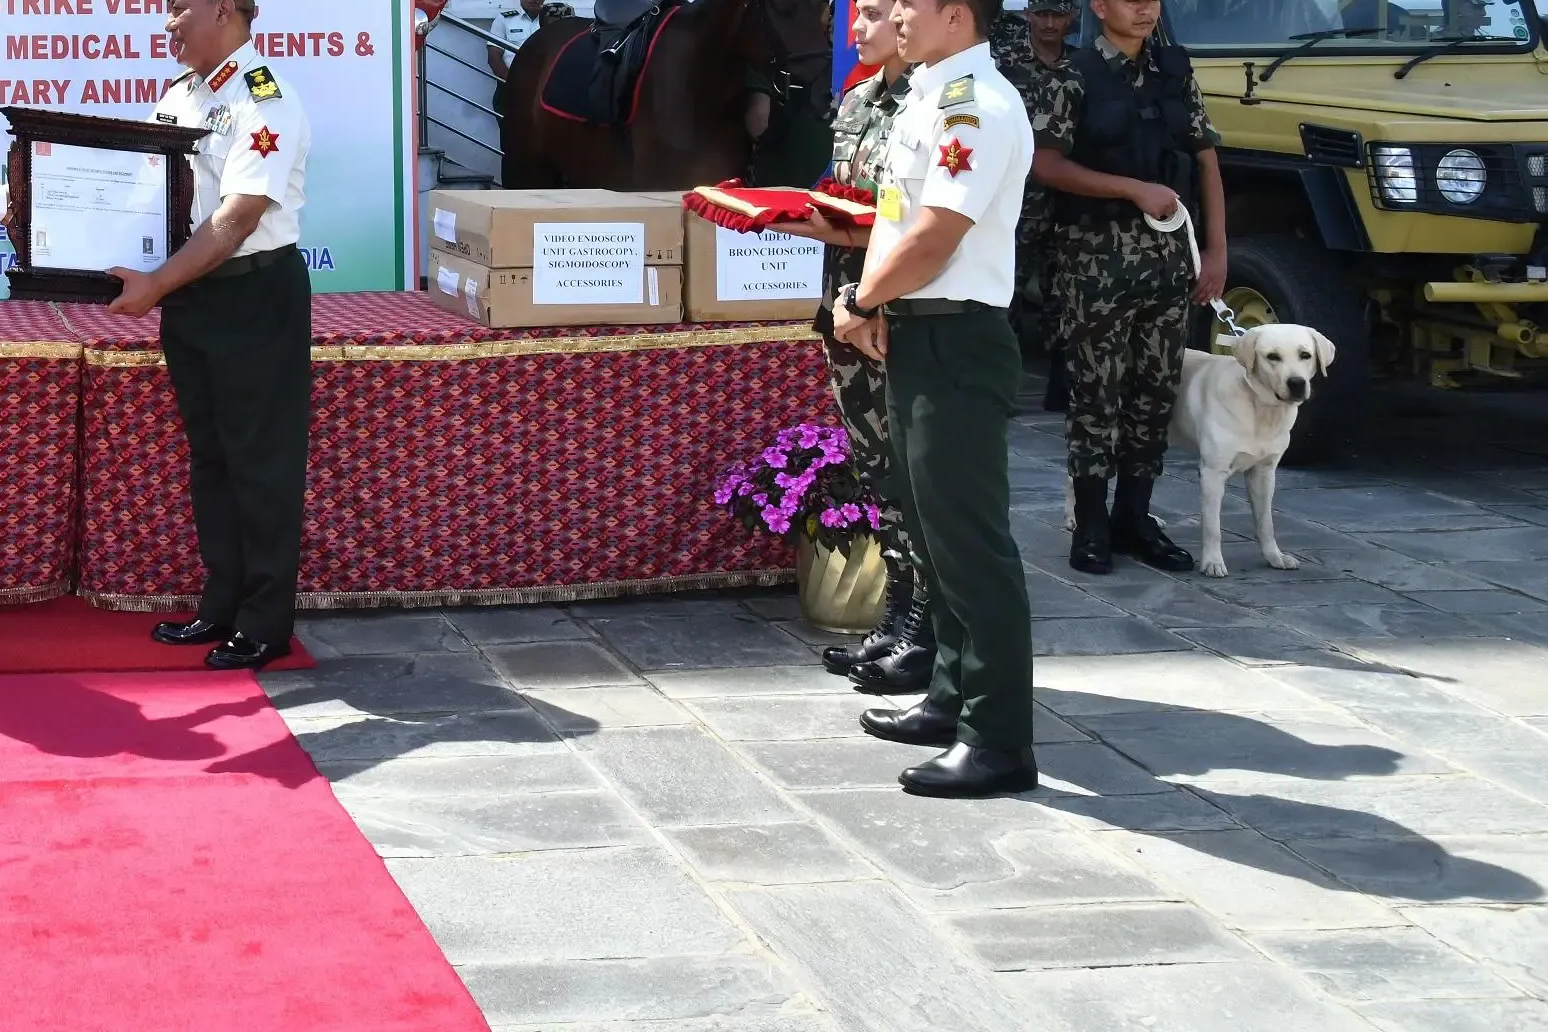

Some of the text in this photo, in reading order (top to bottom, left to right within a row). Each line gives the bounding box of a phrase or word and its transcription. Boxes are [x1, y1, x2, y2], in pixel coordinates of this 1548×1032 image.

[6, 33, 140, 61] MEDICAL
[150, 32, 345, 59] EMENTS
[354, 31, 375, 56] &
[80, 78, 173, 104] ANIMA
[544, 234, 636, 243] VIDEO ENDOSCOPY
[757, 232, 792, 242] VIDEO
[543, 247, 567, 256] UNIT
[729, 246, 820, 257] BRONCHOSCOPE
[299, 247, 334, 270] DIA
[548, 260, 630, 269] SIGMOIDOSCOPY
[761, 261, 788, 271] UNIT
[556, 279, 623, 288] ACCESSORIES
[742, 281, 808, 292] ACCESSORIES
